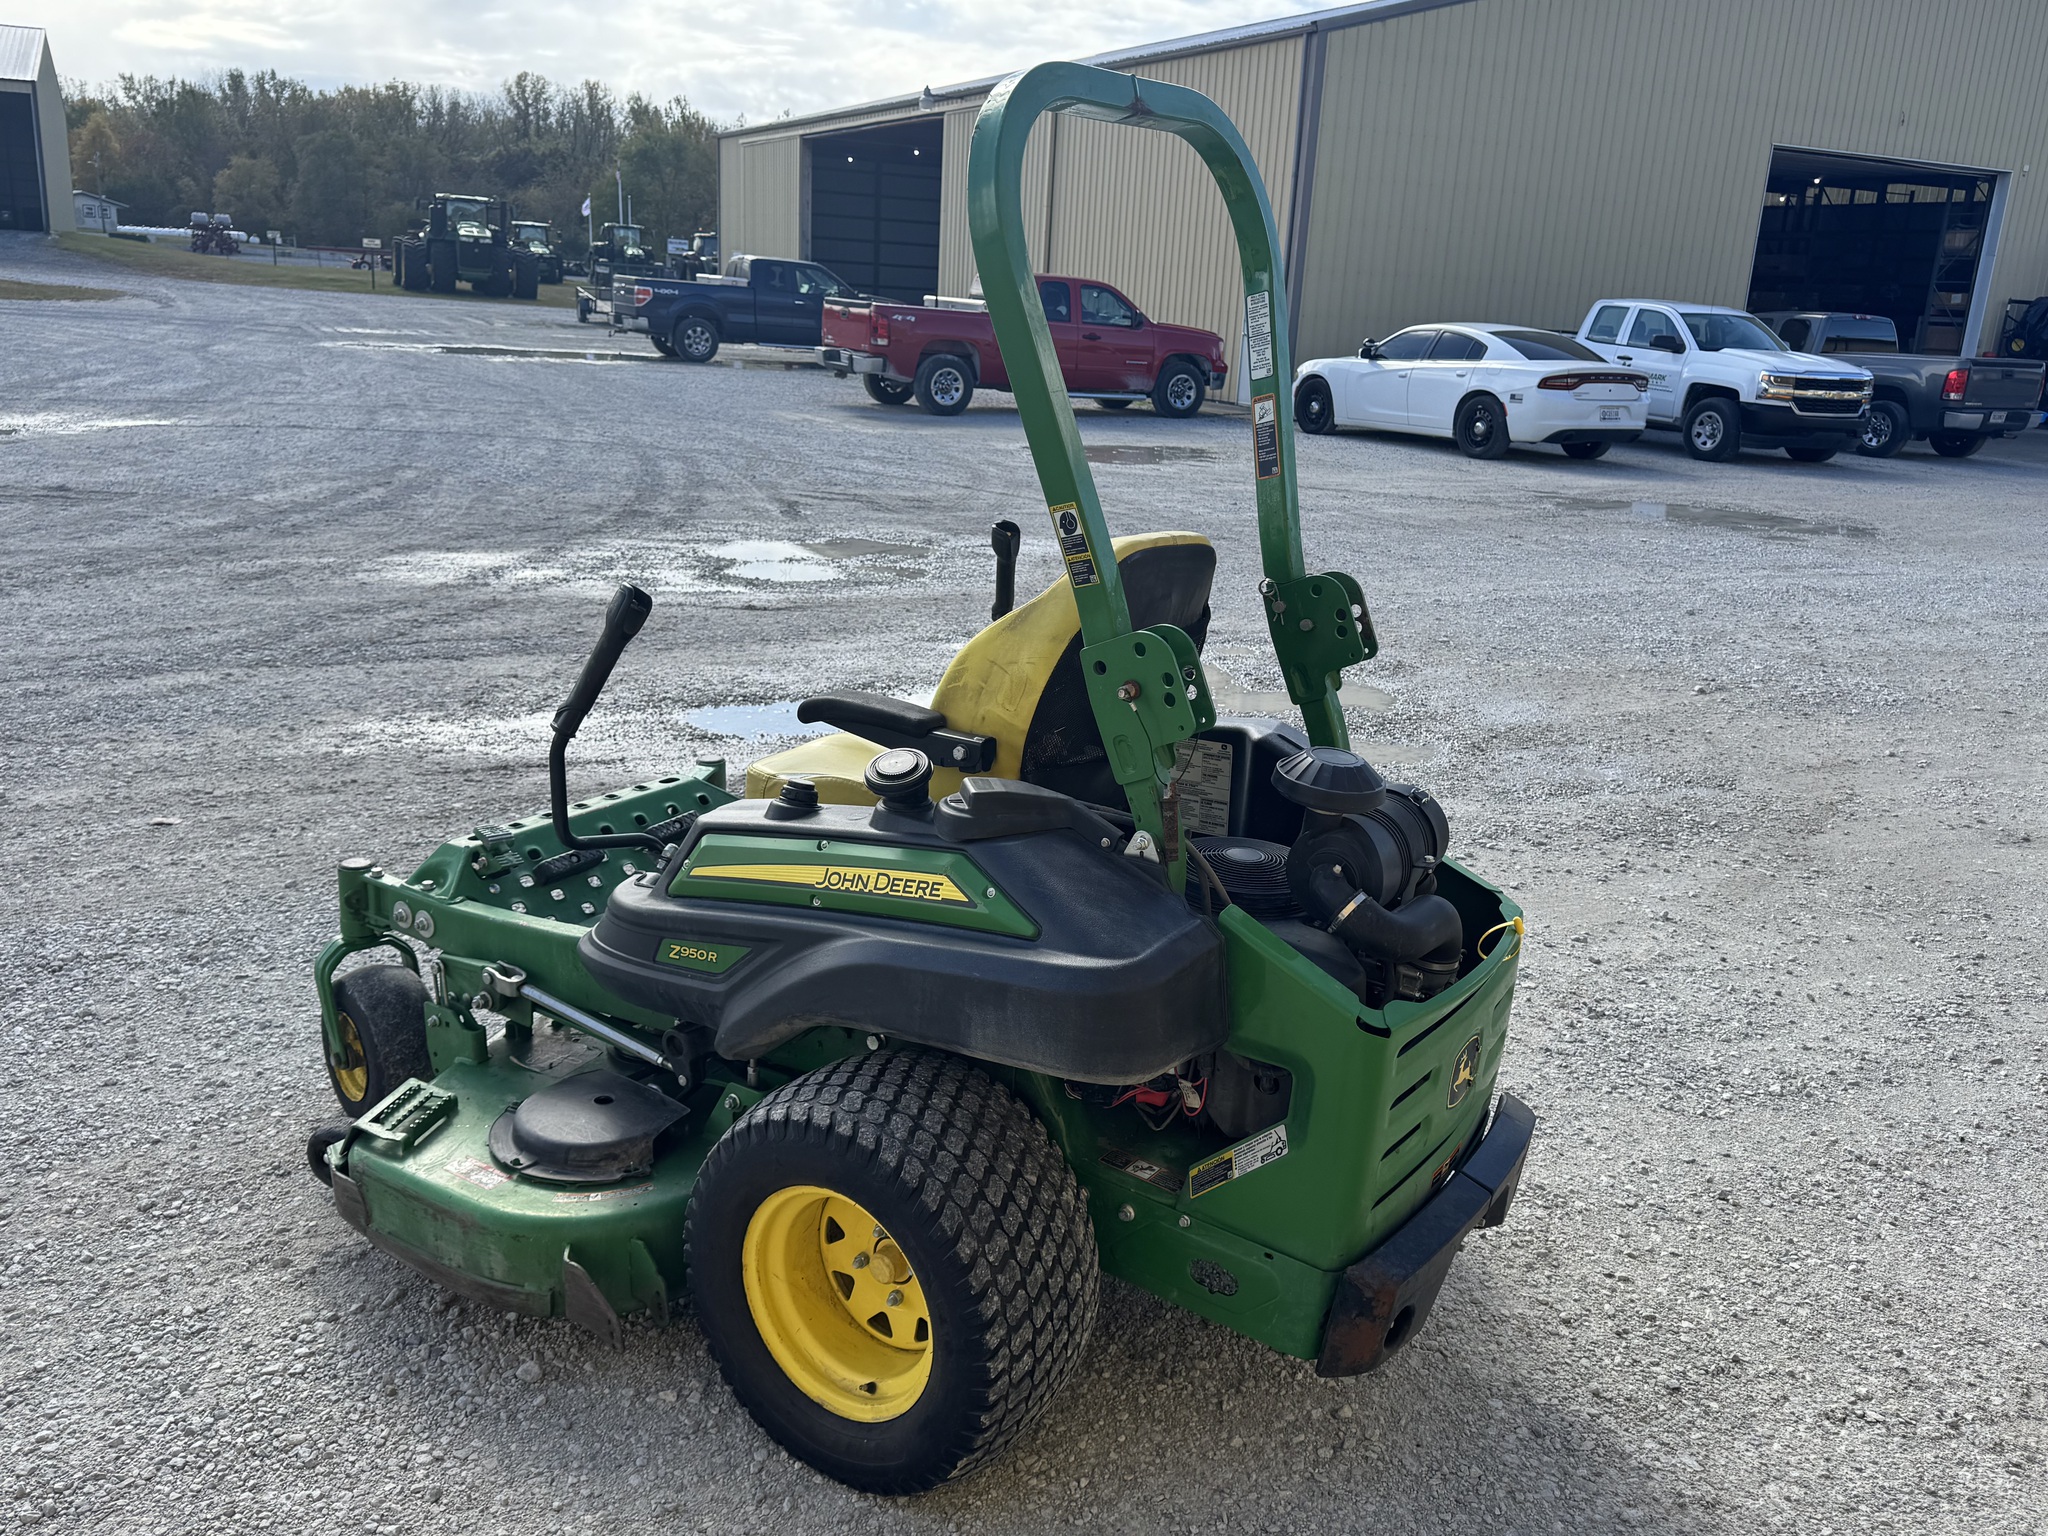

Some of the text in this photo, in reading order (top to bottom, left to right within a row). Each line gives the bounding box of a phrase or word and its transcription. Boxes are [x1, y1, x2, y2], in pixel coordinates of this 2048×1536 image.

[815, 867, 944, 899] JOHN DEERE
[668, 944, 718, 963] Z950R
